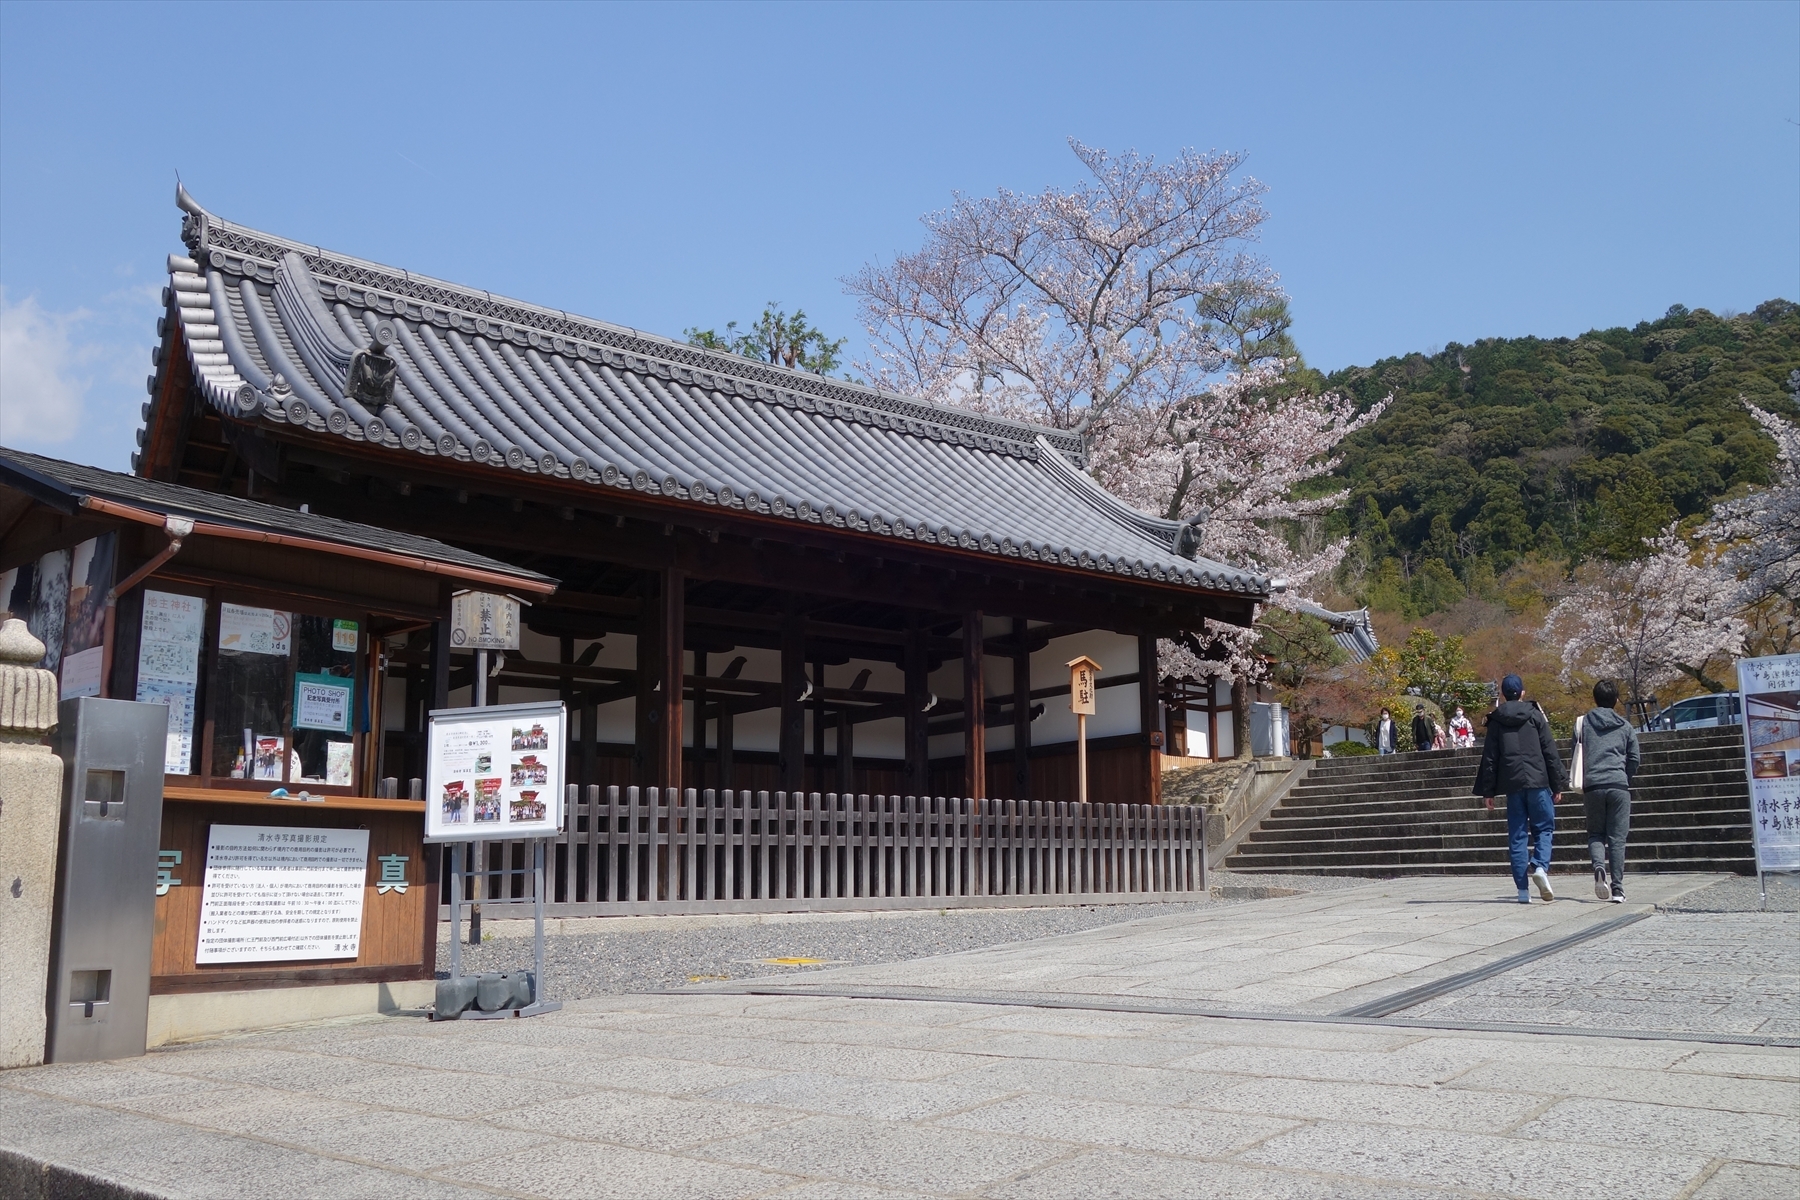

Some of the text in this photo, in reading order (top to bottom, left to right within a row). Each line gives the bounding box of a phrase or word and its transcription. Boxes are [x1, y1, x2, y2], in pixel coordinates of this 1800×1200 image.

[479, 608, 492, 636] 禁止
[335, 631, 356, 647] 119
[1768, 678, 1795, 689] 開催中
[303, 686, 345, 698] PHOTO SHOP
[257, 832, 328, 844] 清水寺写真撮影規定
[376, 853, 410, 895] 真
[333, 943, 356, 952] 清水寺
